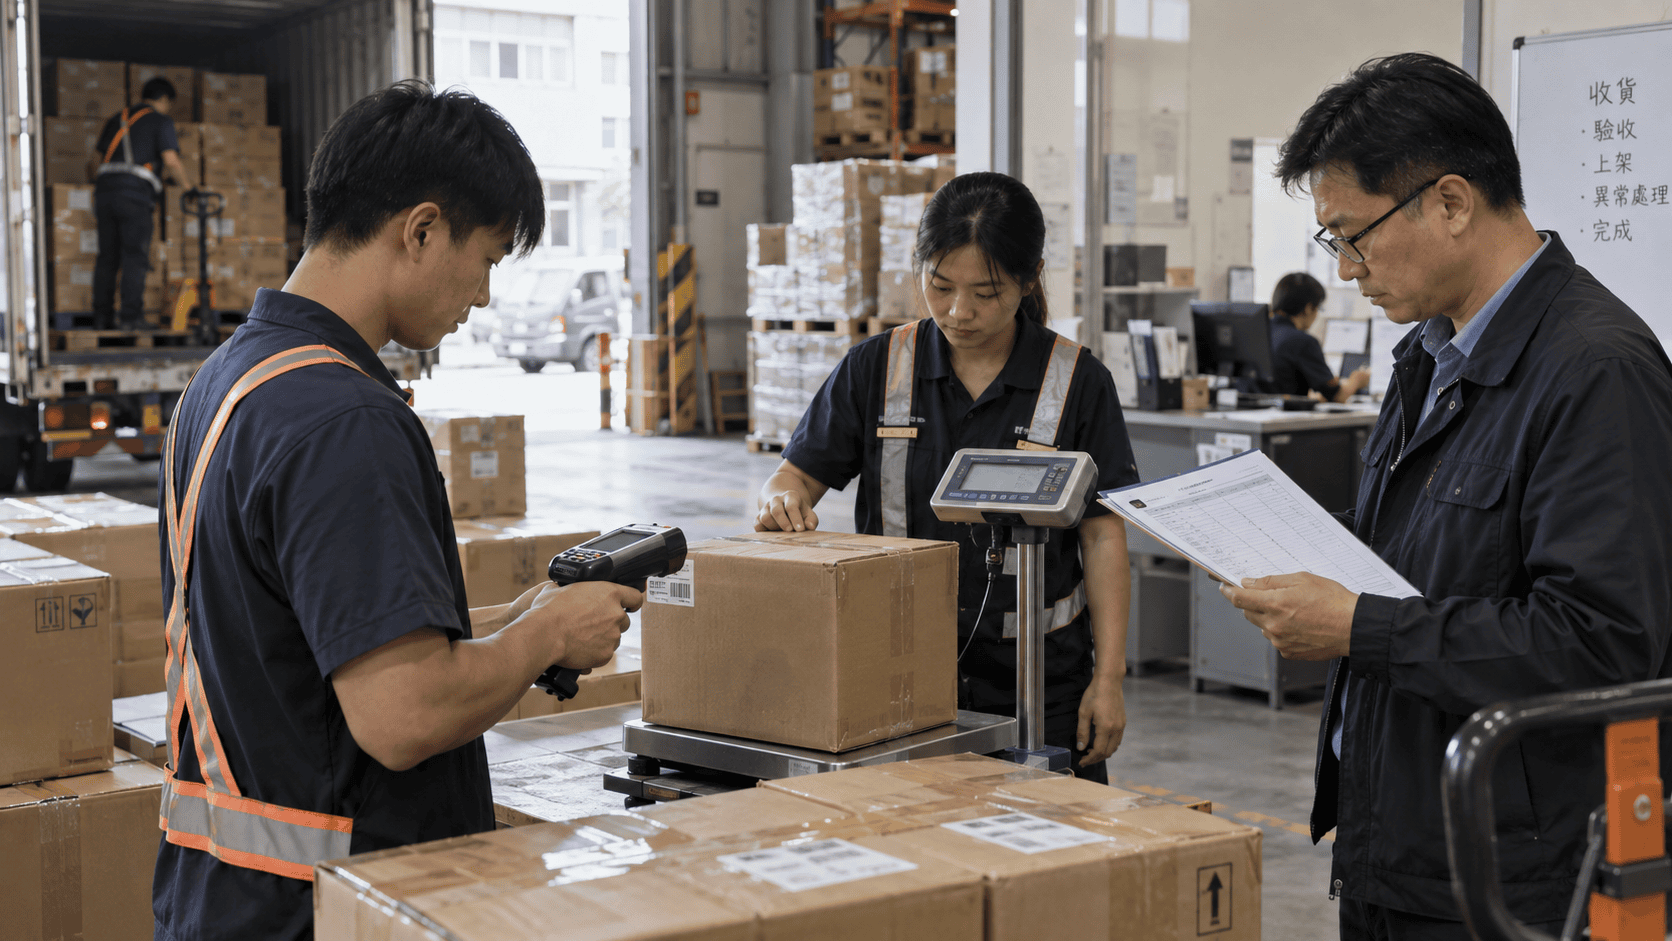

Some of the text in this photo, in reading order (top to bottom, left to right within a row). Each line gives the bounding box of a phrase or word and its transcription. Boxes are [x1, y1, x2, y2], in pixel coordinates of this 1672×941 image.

[1589, 77, 1637, 106] 收貨
[1594, 151, 1632, 174] 上架
[1593, 184, 1670, 208] 異常處理
[1593, 219, 1632, 242] 完成
